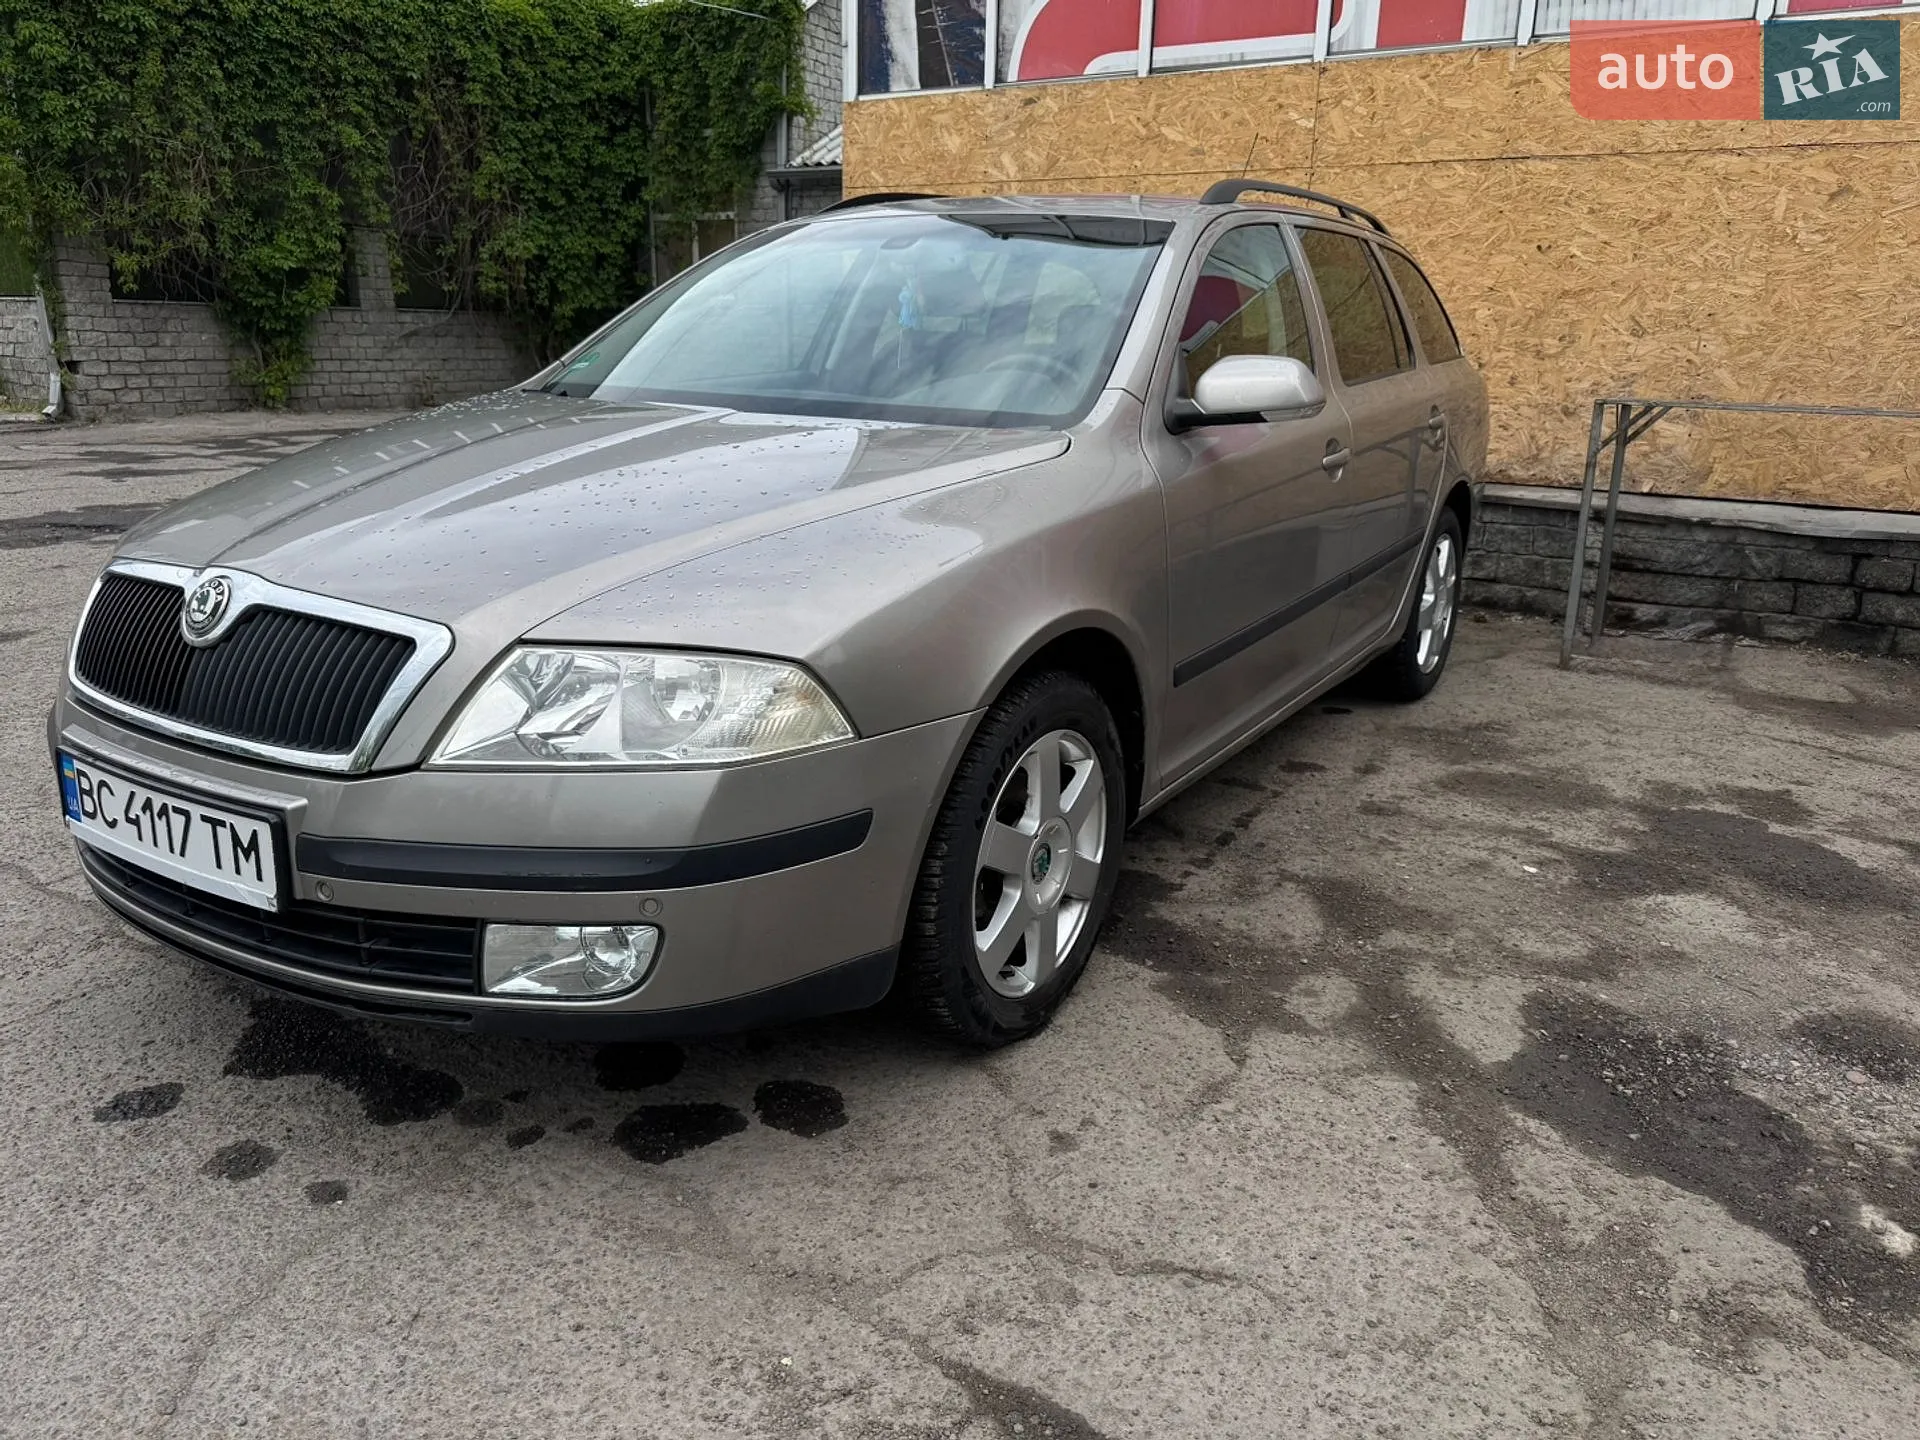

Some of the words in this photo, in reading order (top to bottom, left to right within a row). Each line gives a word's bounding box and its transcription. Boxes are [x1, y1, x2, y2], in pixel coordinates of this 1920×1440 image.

[76, 769, 118, 829] BC
[124, 790, 192, 858] 4117
[200, 814, 264, 882] TM
